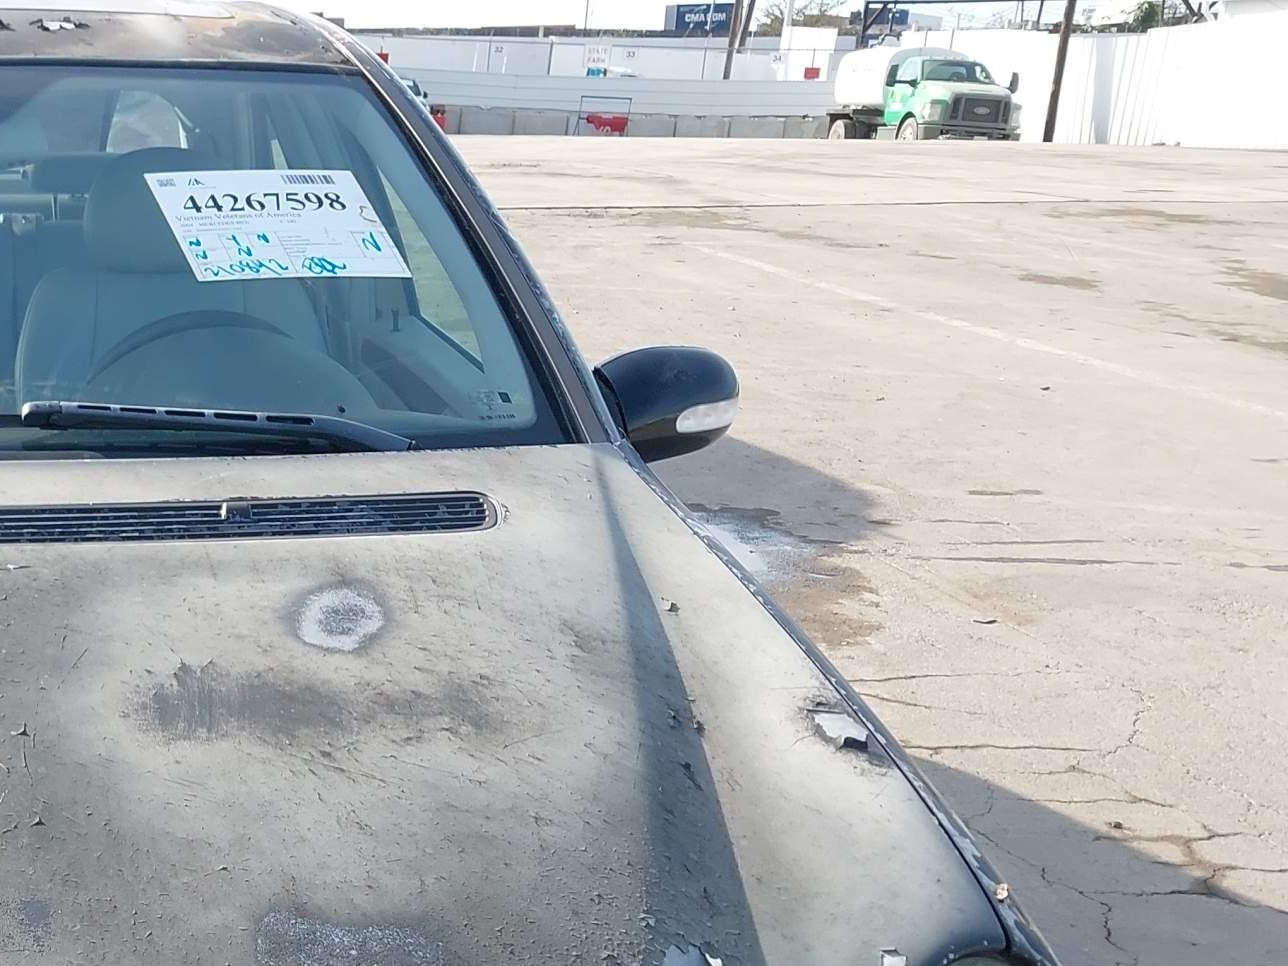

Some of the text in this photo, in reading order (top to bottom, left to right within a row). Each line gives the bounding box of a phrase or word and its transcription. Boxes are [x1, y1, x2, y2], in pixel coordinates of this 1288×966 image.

[685, 12, 705, 23] CMA
[773, 55, 782, 63] 34
[183, 191, 347, 214] 44267598
